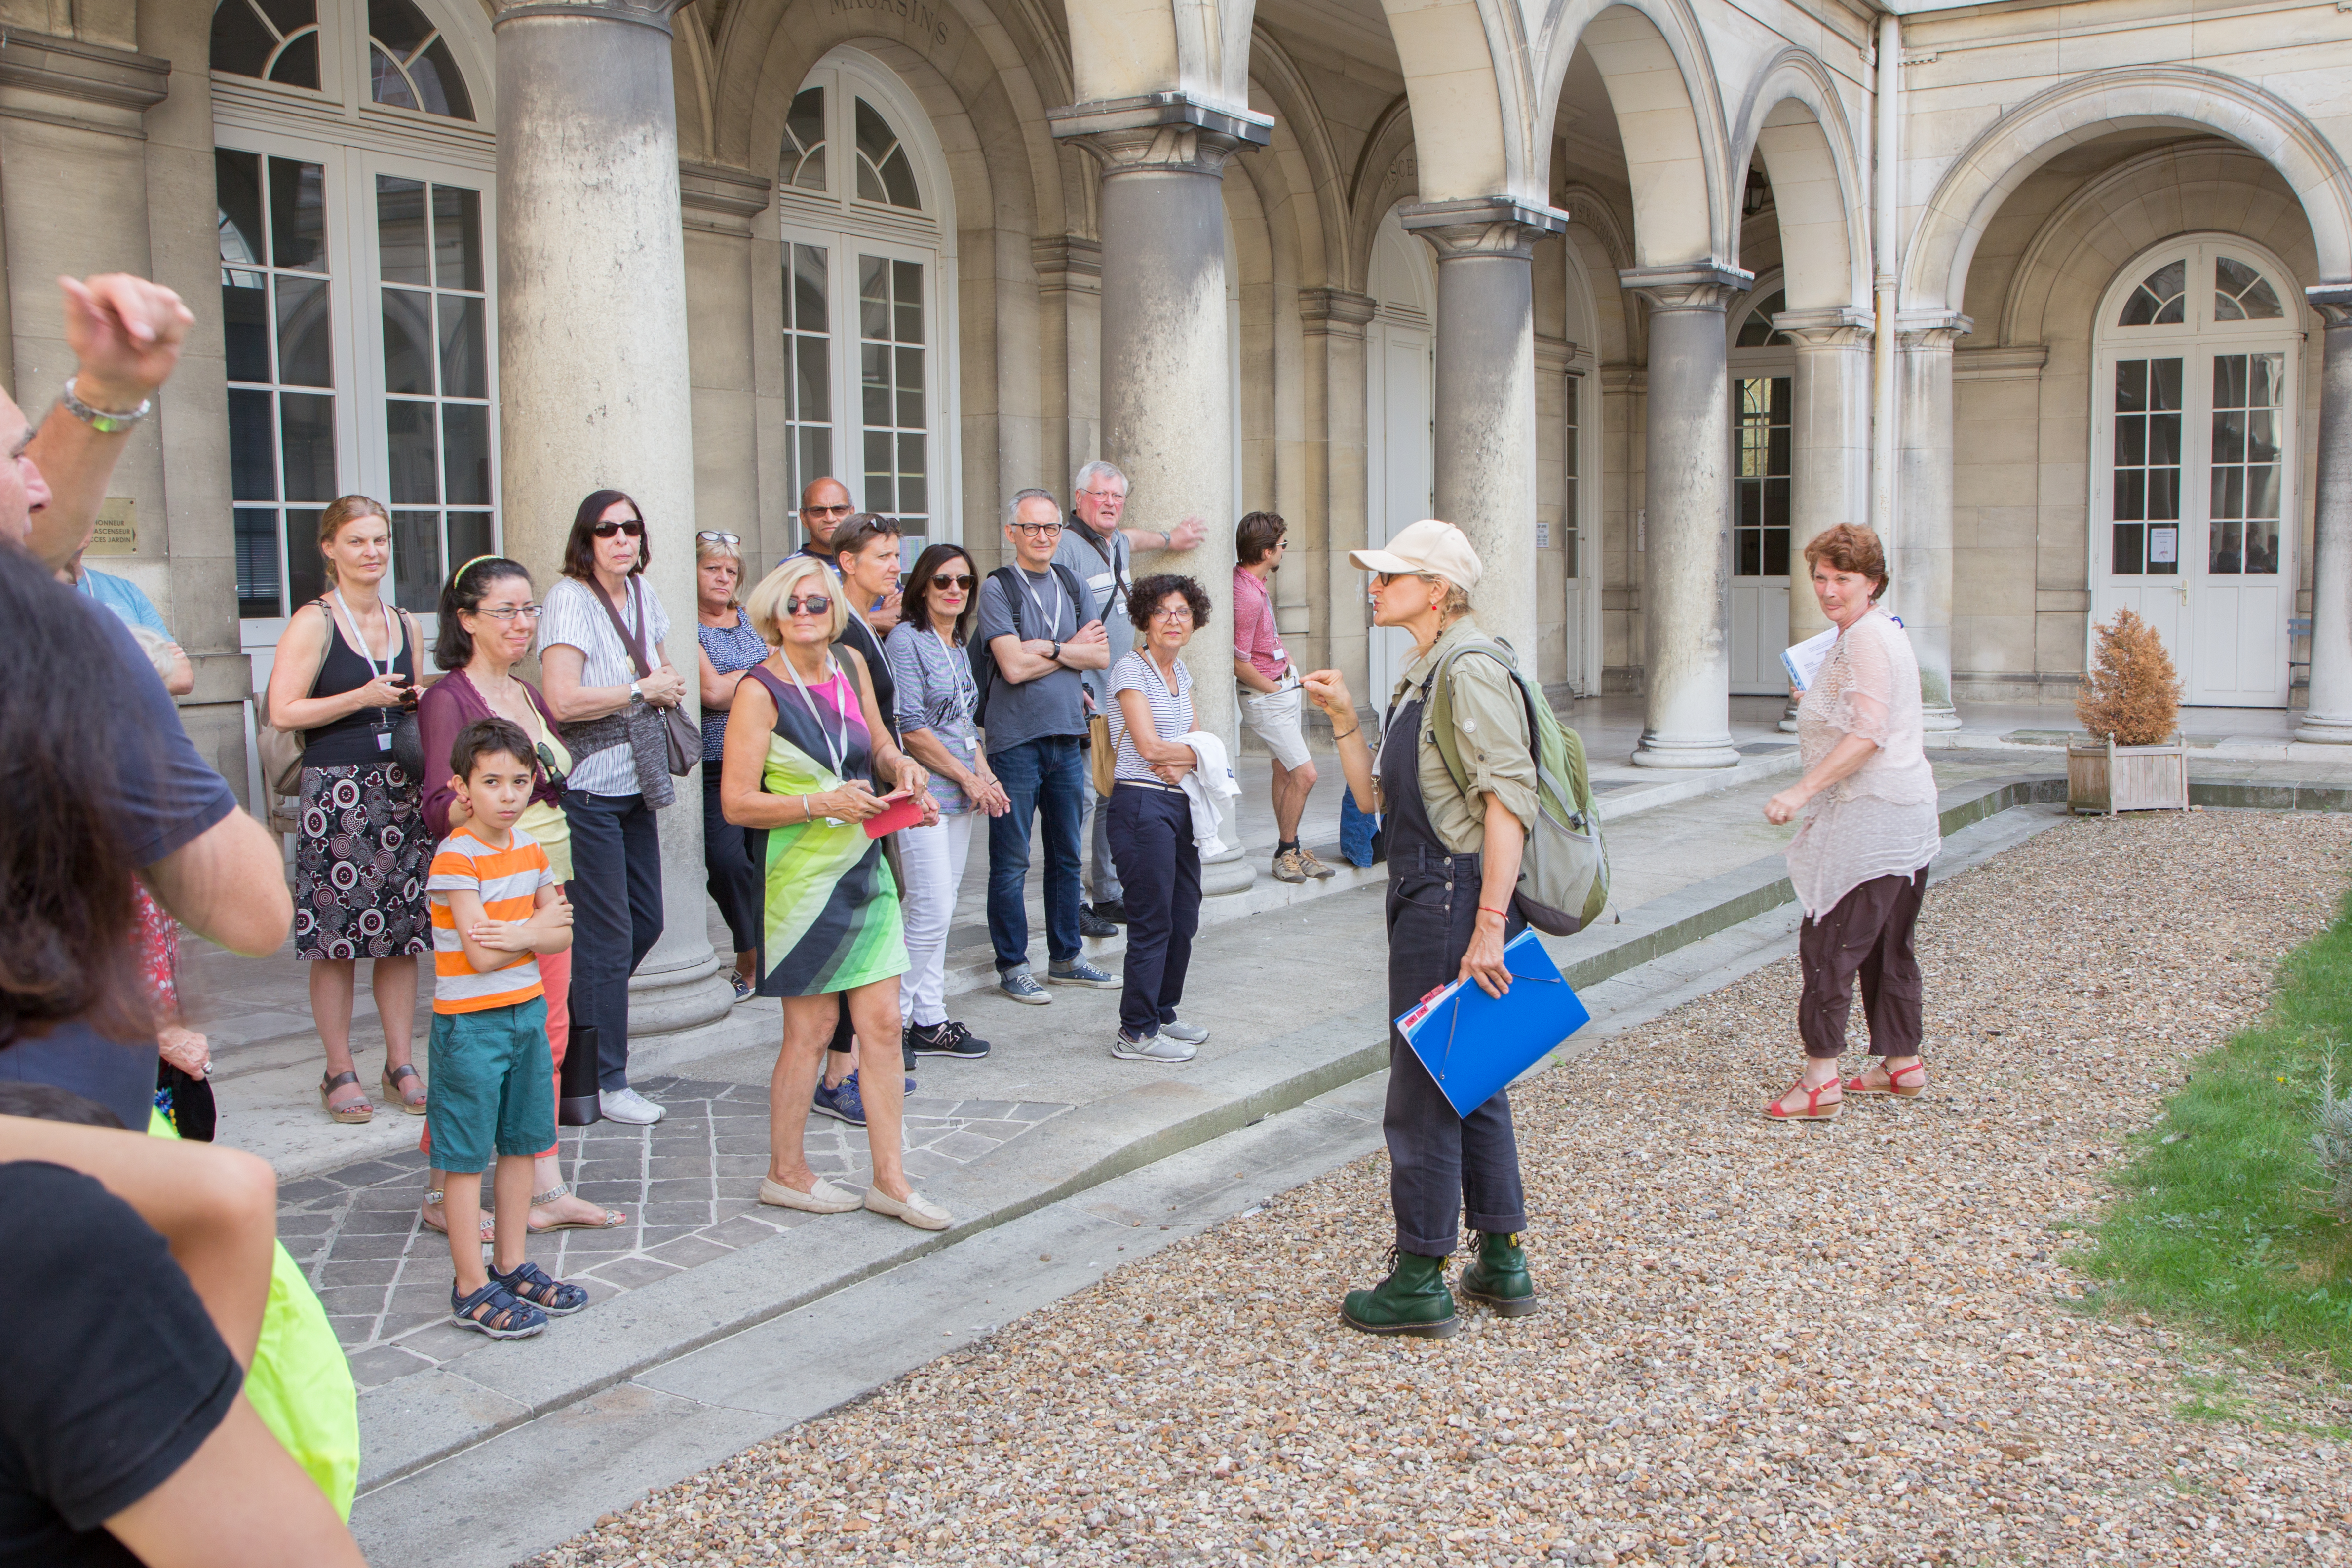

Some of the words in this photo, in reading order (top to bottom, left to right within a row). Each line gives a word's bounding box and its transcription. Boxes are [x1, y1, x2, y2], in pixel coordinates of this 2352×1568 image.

[1384, 158, 1418, 189] ASCE
[1400, 690, 1412, 706] Clamart
[834, 1093, 856, 1111] N
